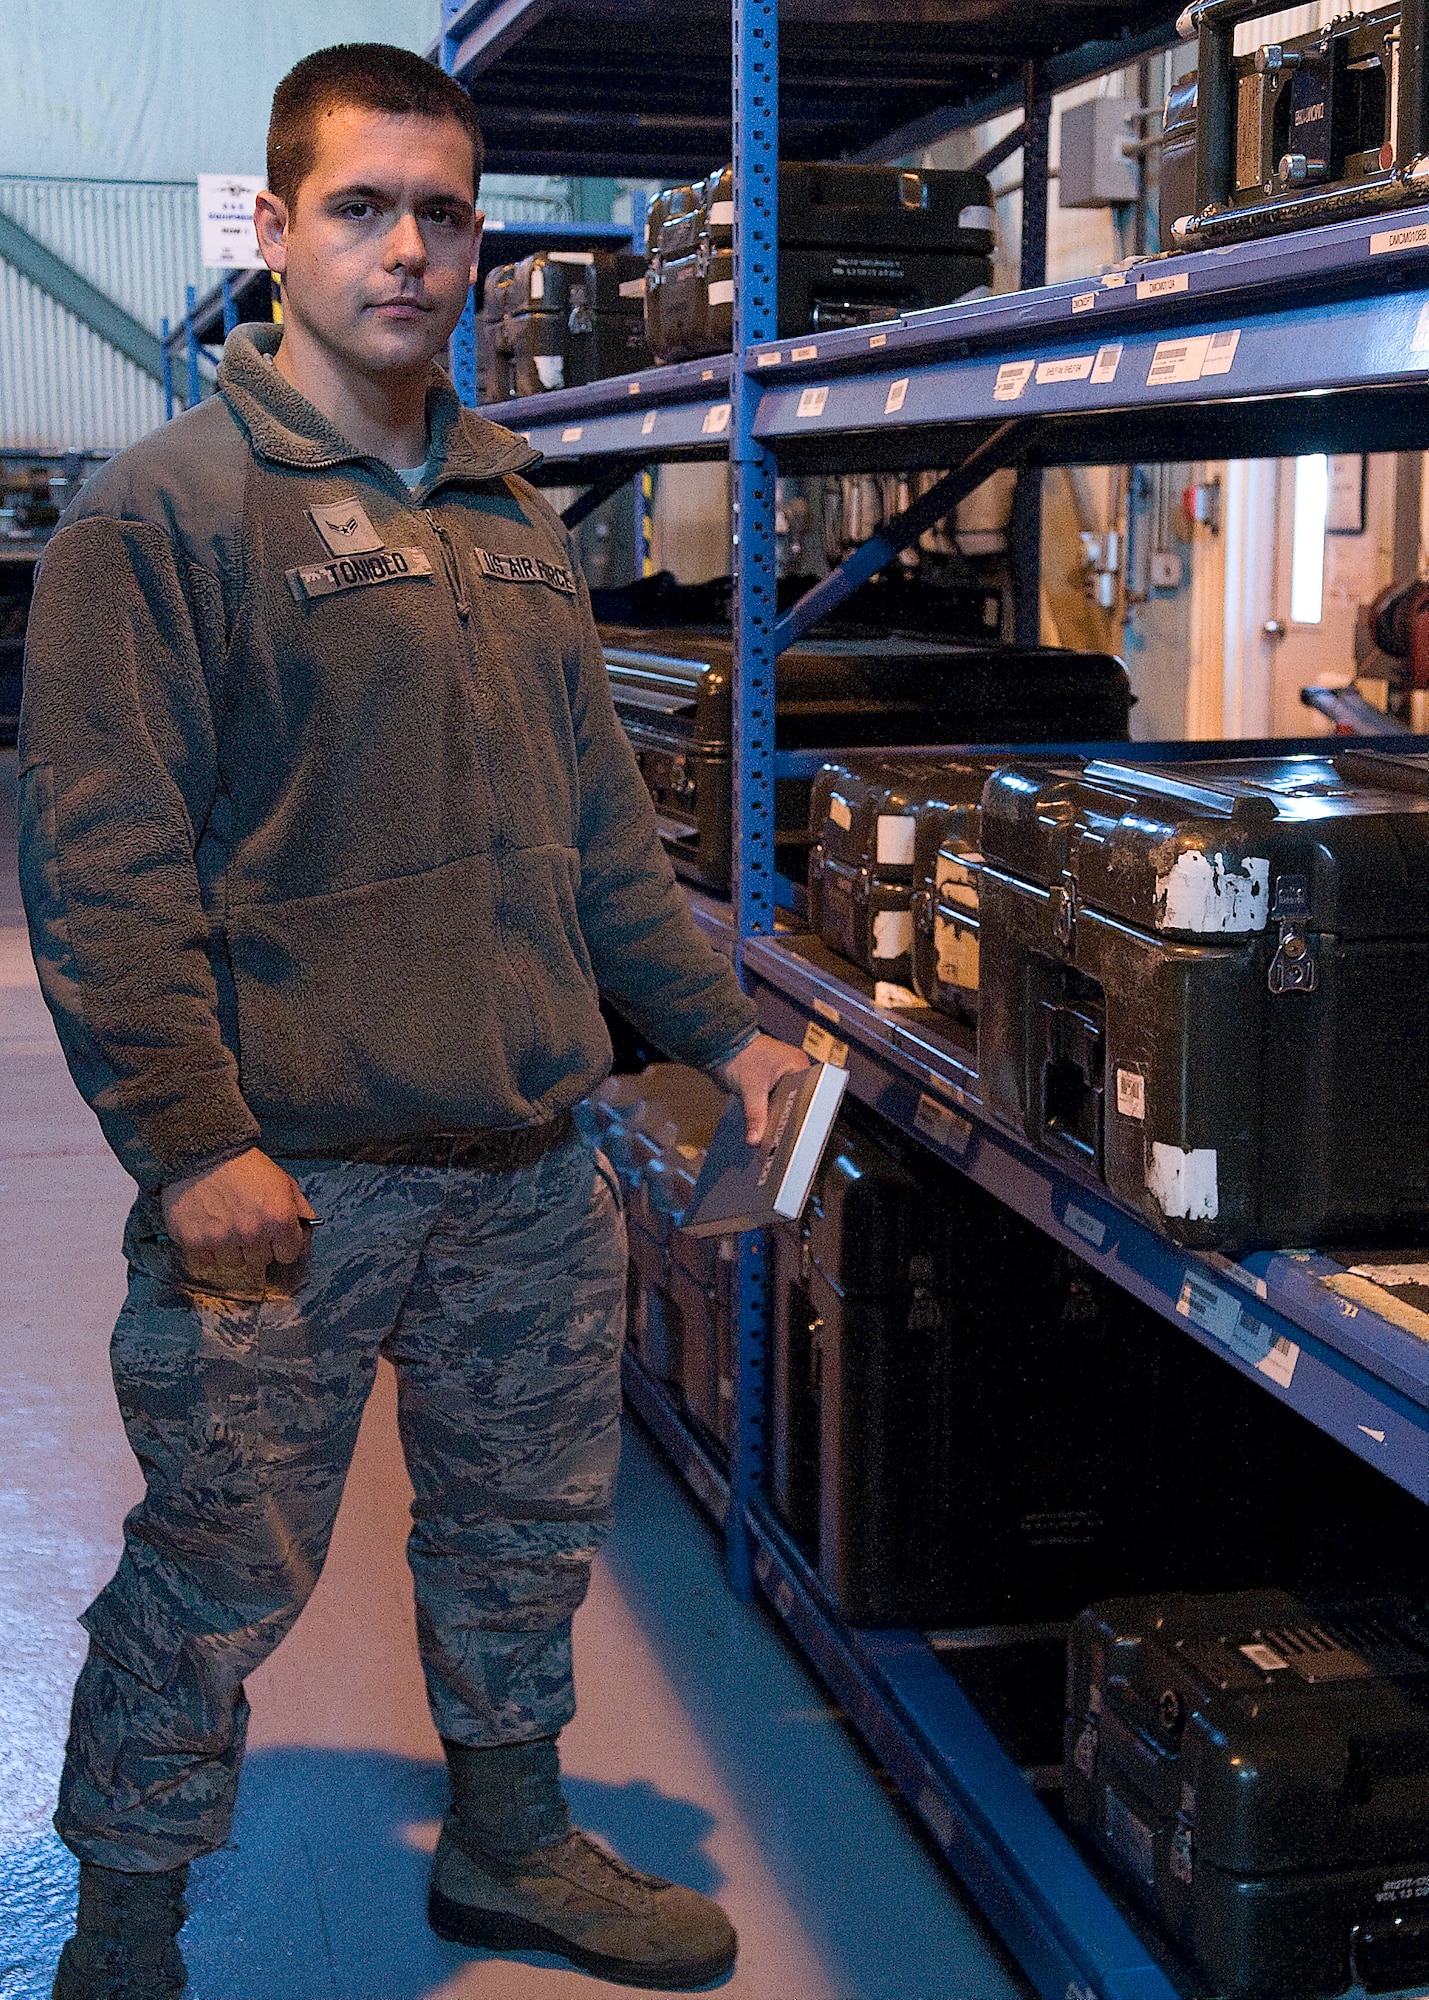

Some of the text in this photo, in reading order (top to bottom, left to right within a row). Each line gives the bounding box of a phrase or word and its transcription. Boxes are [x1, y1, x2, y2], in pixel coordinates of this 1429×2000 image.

[483, 551, 573, 590] US AIR FORCE
